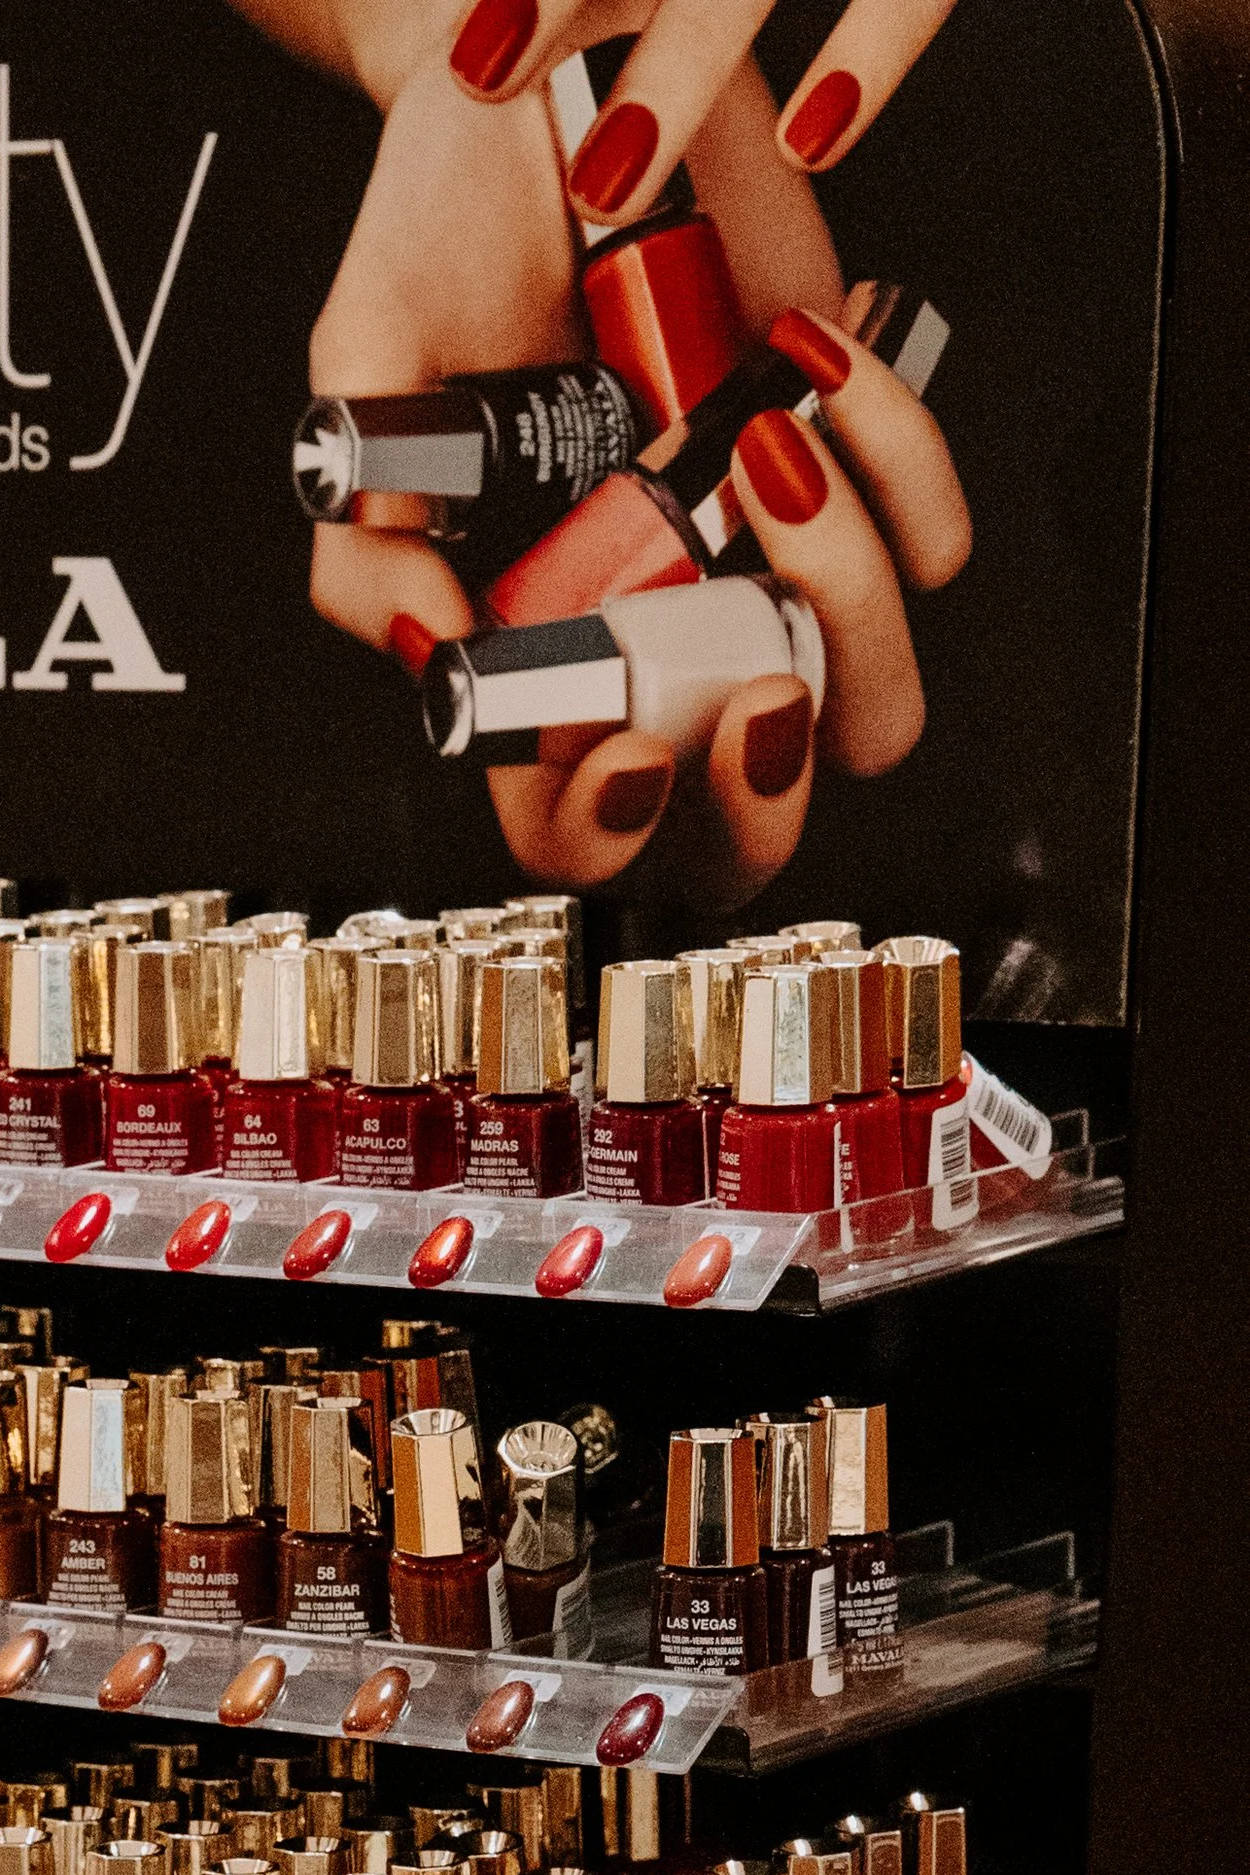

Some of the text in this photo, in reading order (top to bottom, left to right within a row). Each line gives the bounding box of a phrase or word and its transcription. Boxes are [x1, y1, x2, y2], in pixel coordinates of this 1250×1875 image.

[9, 1096, 32, 1112] 241
[9, 1114, 61, 1129] CRYSTAL
[116, 1121, 182, 1135] BORDEAUX
[244, 1114, 262, 1129] 64
[363, 1118, 380, 1133] 63
[480, 1121, 504, 1136] 259
[232, 1132, 277, 1145] BILBAO
[345, 1135, 407, 1150] ACAPULCO
[594, 1128, 613, 1144] 292
[470, 1138, 520, 1153] MADRAS
[588, 1146, 638, 1163] -GERMAIN
[69, 1539, 96, 1554] 243
[61, 1556, 106, 1570] AMBER
[189, 1555, 206, 1569] 81
[871, 1560, 886, 1576] 33
[165, 1571, 239, 1586] BUENOS AIRES
[316, 1566, 336, 1581] 58
[294, 1584, 360, 1597] ZANZIBAR
[846, 1575, 898, 1594] LAS VEGA
[691, 1599, 710, 1614] 33
[666, 1617, 737, 1631] LAS VEGAS
[851, 1648, 902, 1666] MAVAL
